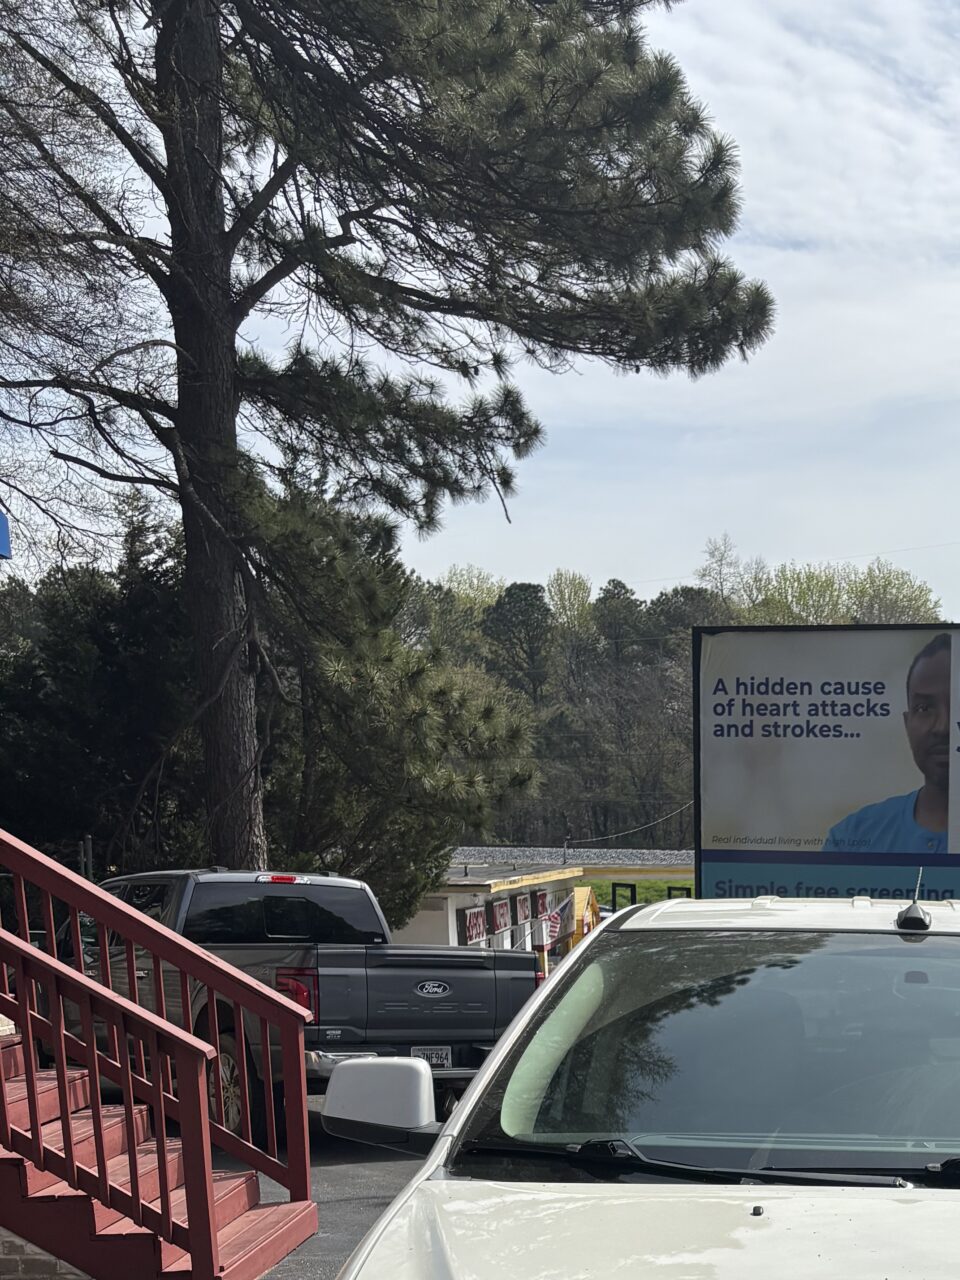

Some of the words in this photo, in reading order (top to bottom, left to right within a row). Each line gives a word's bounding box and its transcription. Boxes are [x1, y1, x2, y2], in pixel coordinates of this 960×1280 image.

[712, 678, 728, 695] A
[735, 676, 812, 695] hidden
[820, 681, 886, 695] cause
[713, 698, 735, 716] of
[741, 698, 800, 716] heart
[807, 698, 890, 716] attacks
[713, 720, 754, 737] and
[761, 720, 861, 738] strokes...
[711, 835, 732, 845] Real
[733, 835, 777, 846] individual
[778, 836, 802, 847] living
[804, 836, 823, 846] with
[714, 880, 789, 899] Simple
[796, 881, 838, 899] free
[846, 882, 955, 901] screening
